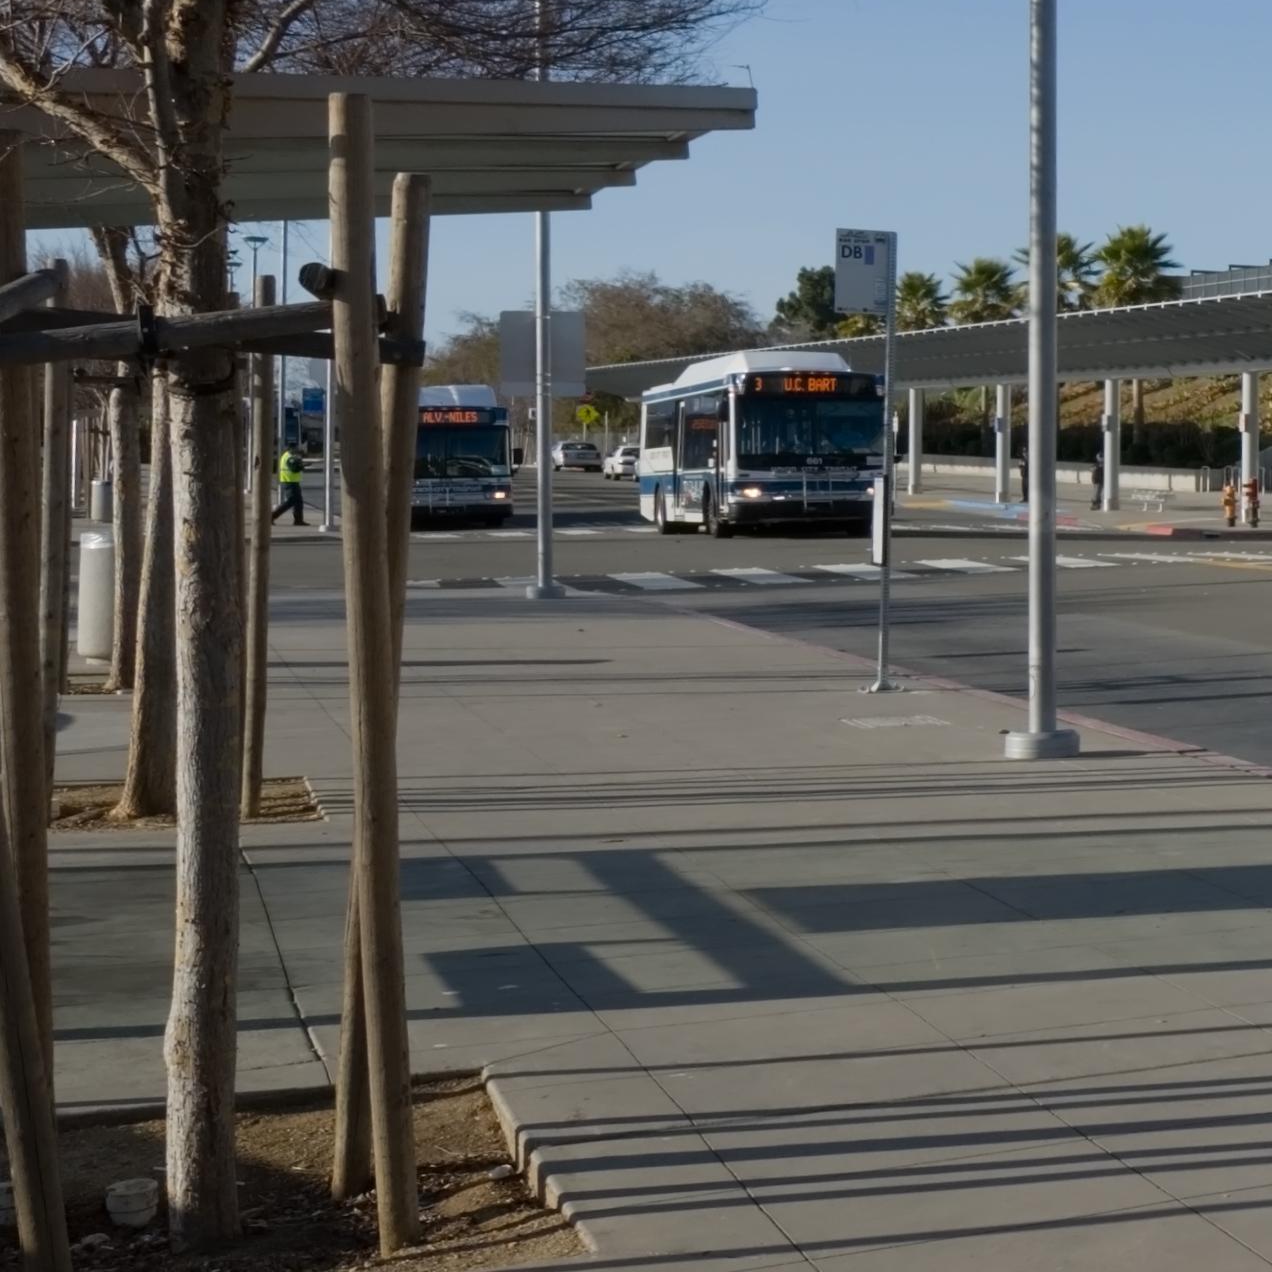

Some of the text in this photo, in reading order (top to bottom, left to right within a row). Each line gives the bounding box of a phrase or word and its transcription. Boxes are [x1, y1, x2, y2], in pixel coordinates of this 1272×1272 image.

[841, 244, 863, 259] DB
[754, 377, 837, 392] 3 U.C. BART
